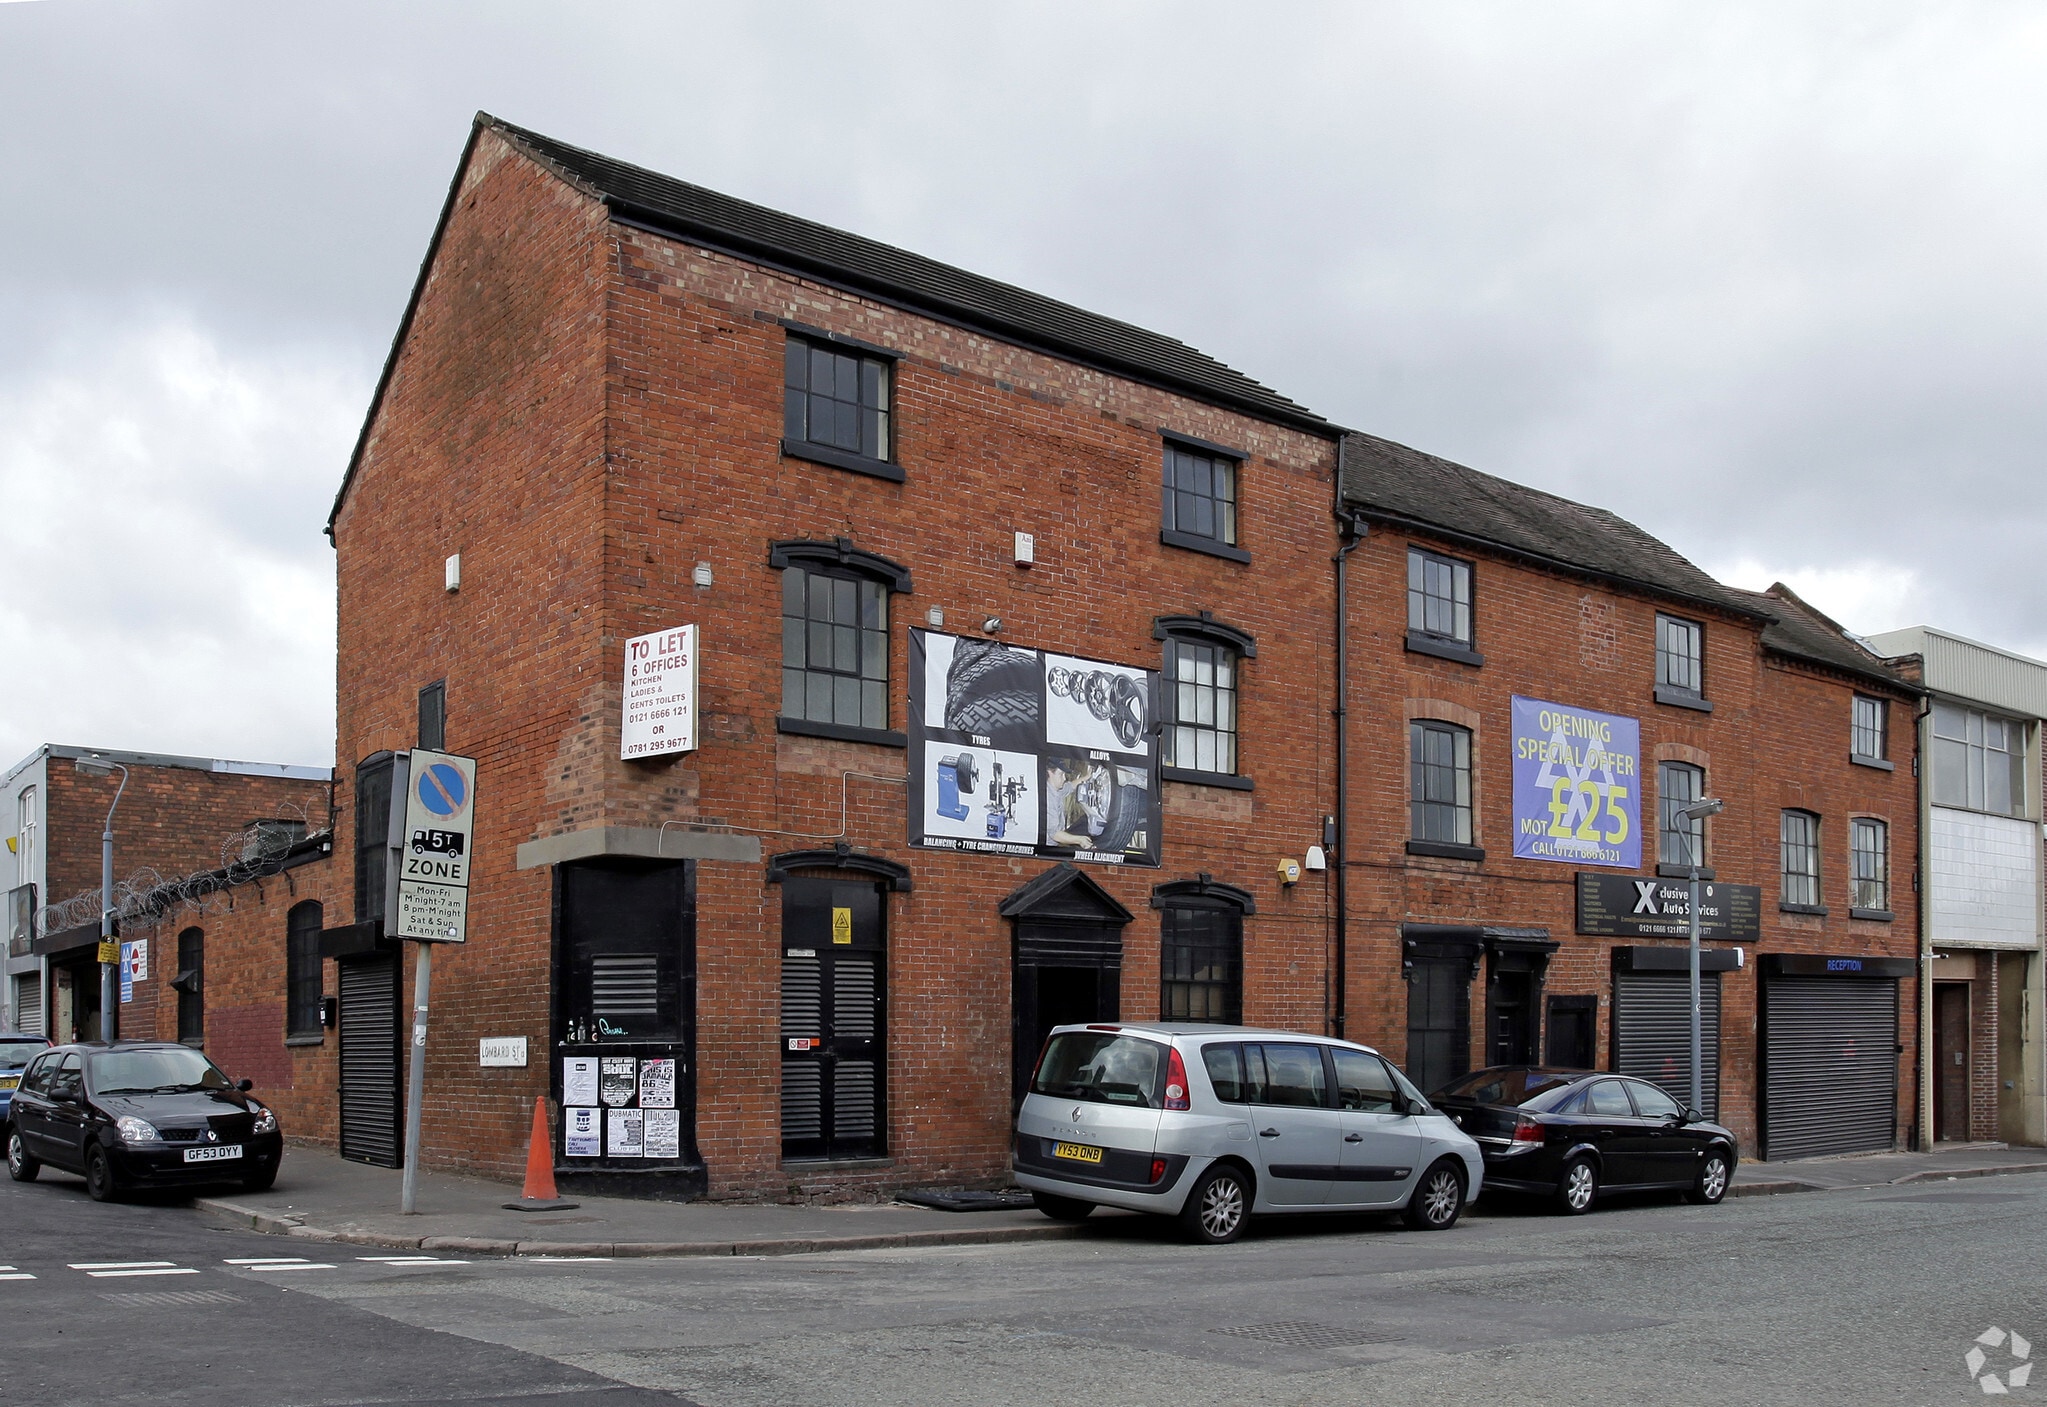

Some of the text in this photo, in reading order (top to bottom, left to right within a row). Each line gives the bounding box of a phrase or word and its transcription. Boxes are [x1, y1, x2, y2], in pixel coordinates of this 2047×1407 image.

[631, 631, 687, 661] TO LET
[631, 654, 688, 677] 6 OFFICES
[631, 674, 663, 687] KITCHEN
[630, 685, 663, 698] LADIES &
[630, 693, 686, 710] GENTS TOILETS
[629, 705, 688, 723] 0121 6666 121
[652, 724, 665, 735] OR
[1539, 710, 1611, 743] OPENING
[628, 737, 688, 754] 0781 295 9677
[971, 734, 991, 746] TYRES
[1089, 750, 1110, 761] ALLOYS
[1517, 736, 1634, 777] SPECIAL OFFER
[1521, 776, 1629, 845] MOT £25
[923, 837, 957, 849] BALANCING
[962, 840, 977, 850] TYRE
[977, 841, 1006, 853] CHANGING
[1005, 844, 1035, 855] MACHINES
[1532, 841, 1620, 862] CALL 0121 666 6121
[1074, 850, 1125, 864] WHEEL ALIGNMENT
[408, 859, 461, 879] ZONE
[416, 886, 451, 897] Mon-Fri
[404, 894, 461, 908] M'night-7 am
[403, 904, 461, 918] 8 pm-M'night
[1663, 903, 1684, 915] Auto
[1684, 903, 1719, 917] Svices
[410, 915, 453, 928] Sat & Sun
[1638, 924, 1653, 933] 0121
[407, 925, 418, 934] At
[419, 927, 435, 936] any
[1826, 959, 1862, 971] RECEPTION
[602, 1063, 634, 1075] SOUL
[641, 1079, 656, 1088] 86
[609, 1110, 642, 1118] DUBMATIC
[188, 1146, 238, 1160] GF53 OYY
[1057, 1143, 1100, 1160] YY53 ONB
